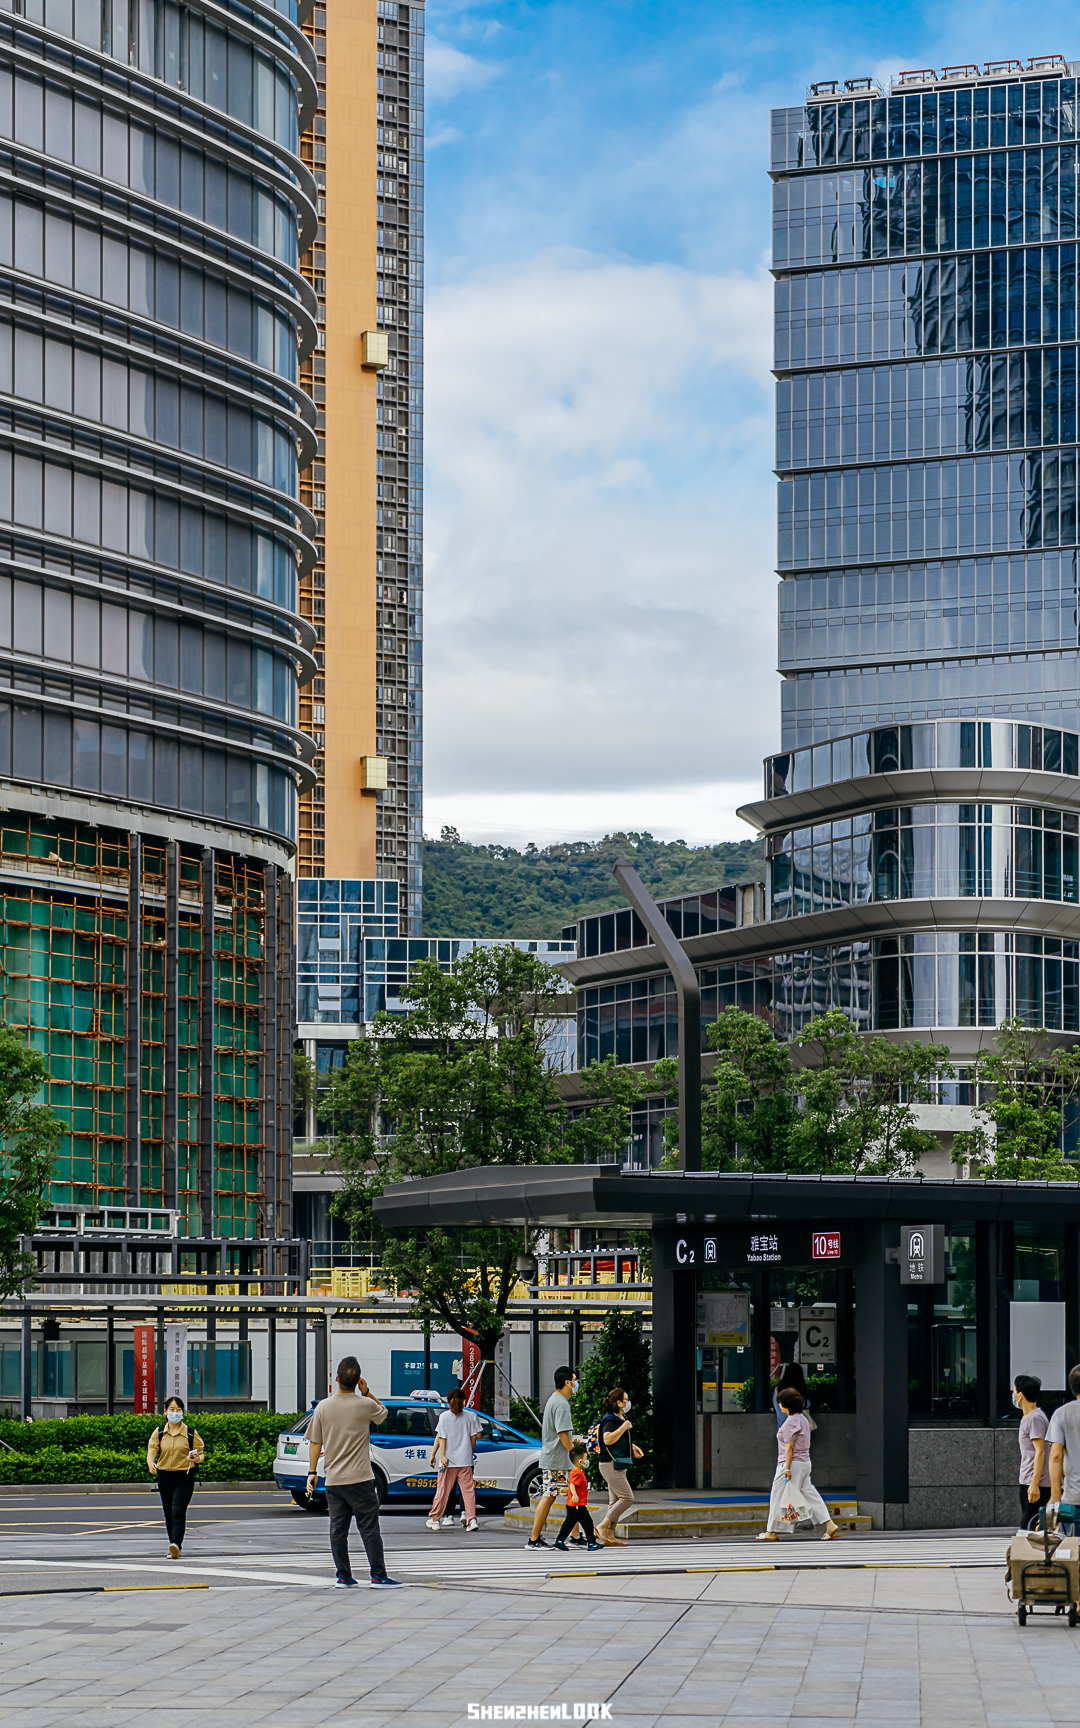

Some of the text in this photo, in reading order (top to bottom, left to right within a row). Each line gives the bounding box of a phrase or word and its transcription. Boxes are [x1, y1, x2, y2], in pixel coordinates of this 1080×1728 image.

[750, 1234, 778, 1252] 雅宝站
[746, 1253, 781, 1262] Yabao Station
[909, 1262, 924, 1272] 地铁
[405, 1449, 427, 1459] 华程
